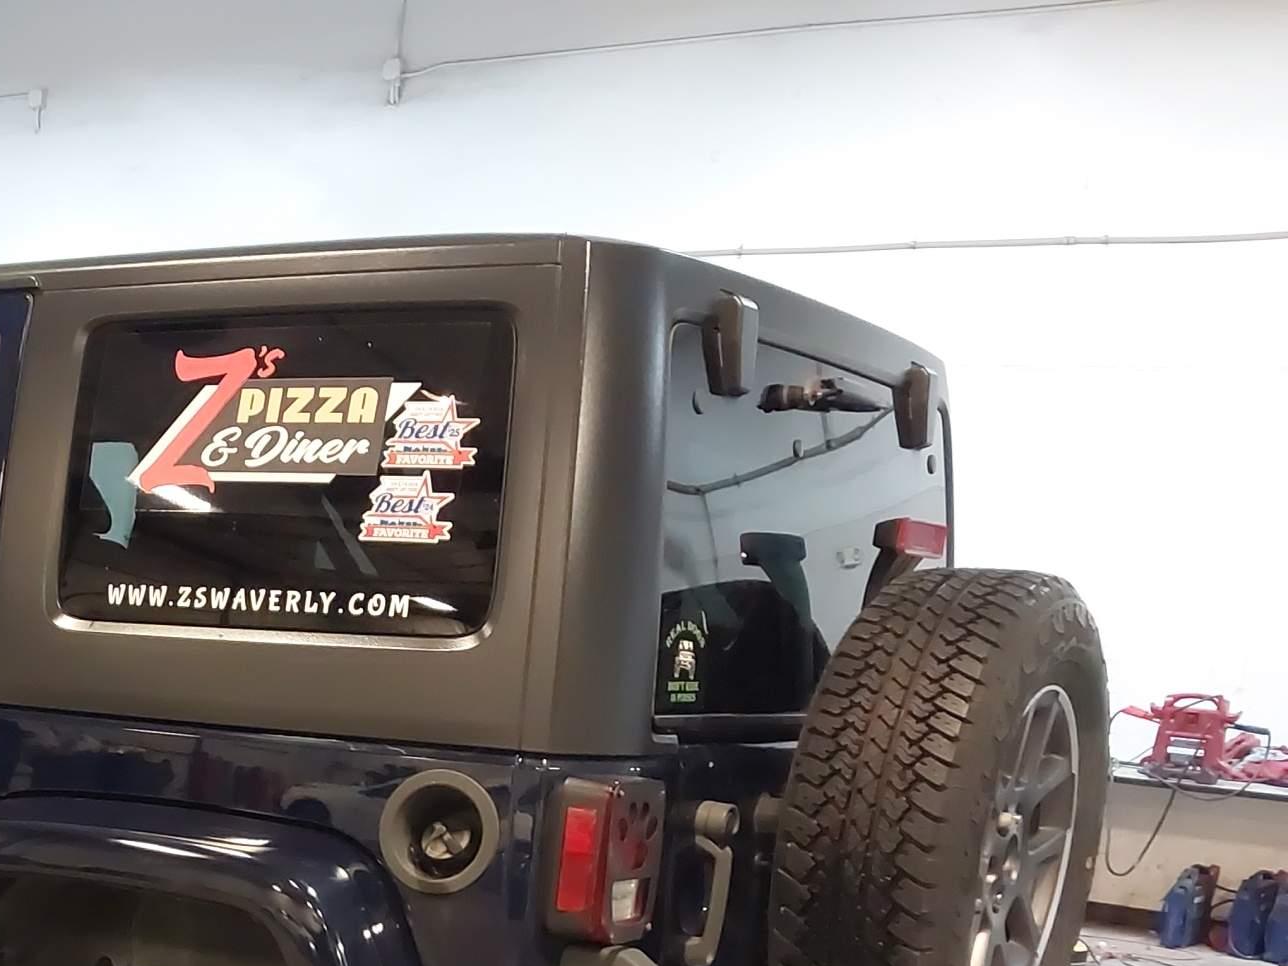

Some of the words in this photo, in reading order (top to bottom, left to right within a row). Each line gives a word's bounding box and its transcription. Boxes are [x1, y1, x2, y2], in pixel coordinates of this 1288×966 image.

[236, 386, 380, 425] PIZZA
[398, 417, 451, 439] Best
[200, 426, 242, 467] &
[244, 425, 371, 468] Diner
[395, 454, 455, 465] FAVORITE
[374, 493, 426, 514] Best
[372, 528, 430, 539] FAVORITE
[107, 583, 411, 619] WWW.ZSWAVERLY.COM
